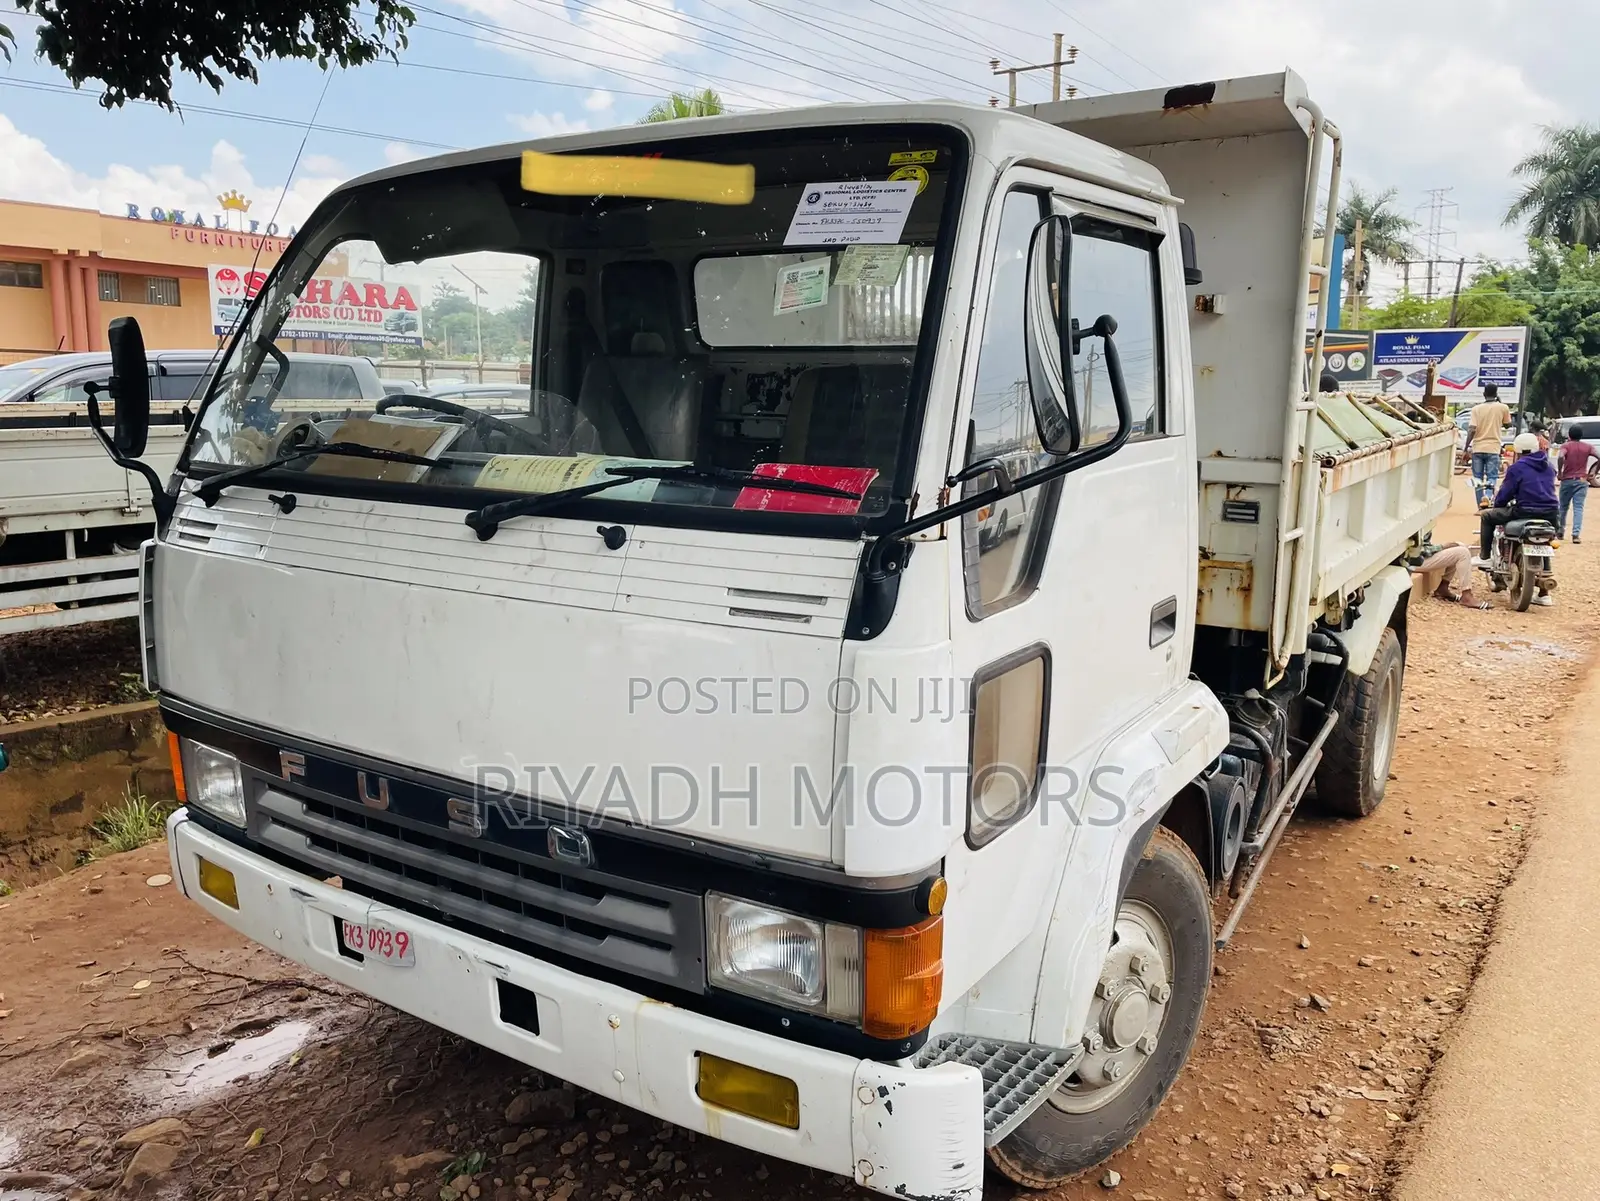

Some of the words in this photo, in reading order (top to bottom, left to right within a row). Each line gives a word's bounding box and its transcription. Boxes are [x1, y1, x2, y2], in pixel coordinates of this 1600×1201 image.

[249, 219, 298, 240] FOA
[243, 270, 419, 311] SHARA
[288, 305, 331, 320] OTORS
[334, 306, 355, 321] (U)
[357, 308, 383, 323] LTD
[279, 750, 595, 867] FUSO
[368, 928, 409, 959] 0939
